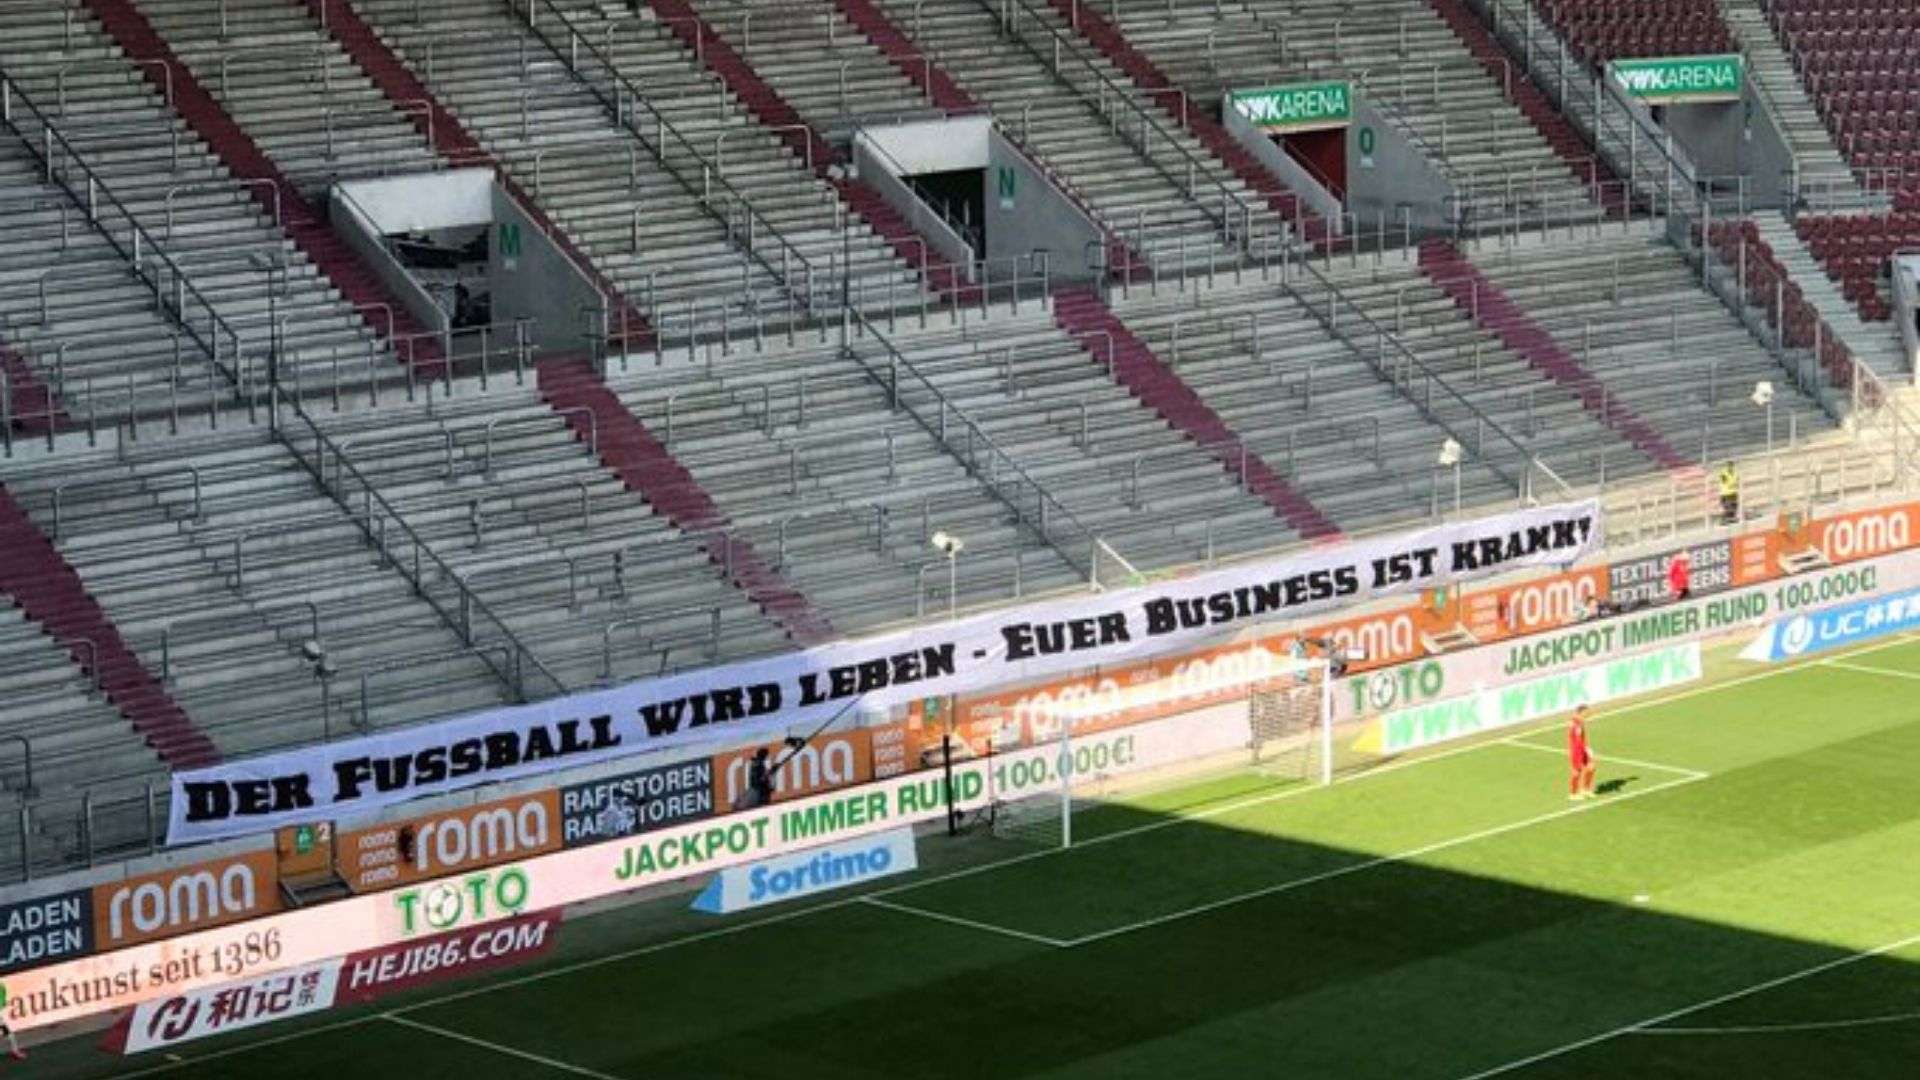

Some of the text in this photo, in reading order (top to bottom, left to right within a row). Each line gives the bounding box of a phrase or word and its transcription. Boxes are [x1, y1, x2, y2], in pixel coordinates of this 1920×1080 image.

[1000, 168, 1015, 196] N
[501, 224, 520, 252] M
[1824, 511, 1909, 561] roma
[1504, 625, 1616, 675] JACKPOT
[1623, 607, 1700, 648] IMMER
[1707, 592, 1767, 627] RUND
[183, 772, 314, 822] DER
[333, 715, 622, 801] FUSSBALL
[638, 682, 783, 738] WIRD
[799, 643, 956, 706] LEBEN
[1001, 613, 1130, 661] EUER
[1144, 564, 1358, 636] BUSINESS
[1371, 548, 1438, 588] IST
[416, 800, 549, 872] roma
[615, 817, 769, 880] JACKPOT
[782, 790, 888, 842] IMMER
[898, 771, 983, 815] RUND
[109, 864, 255, 939] roma
[749, 846, 891, 900] Sortimo
[150, 950, 202, 987] seit
[212, 927, 281, 975] 1386
[350, 921, 549, 989] HEJI86.COM
